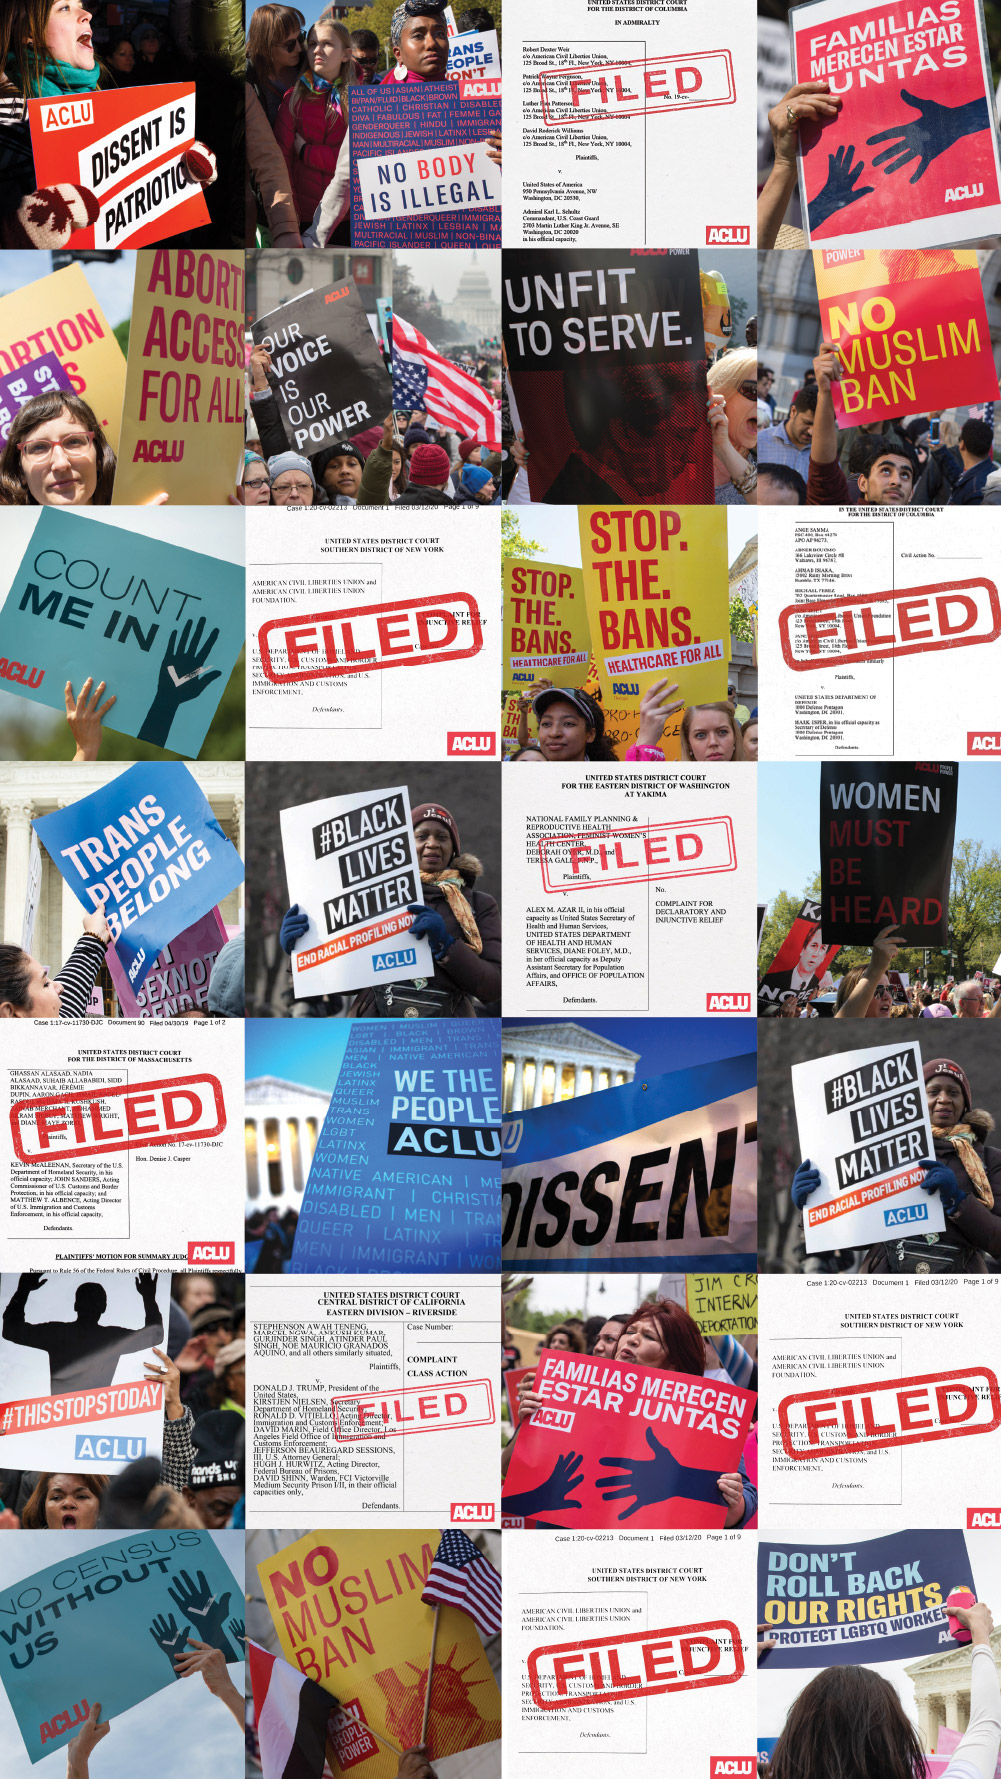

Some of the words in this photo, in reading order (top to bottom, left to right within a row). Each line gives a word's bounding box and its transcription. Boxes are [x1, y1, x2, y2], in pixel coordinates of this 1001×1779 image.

[810, 1, 961, 57] FAMILIAS
[810, 37, 898, 78] MERECEN
[904, 22, 963, 54] ESTAR
[817, 46, 968, 94] UNTAS
[464, 83, 502, 97] ACLU
[569, 66, 703, 107] FILED
[45, 102, 91, 128] ACLU
[92, 116, 162, 188] DISSENT
[170, 107, 185, 139] IS
[377, 162, 407, 185] NO
[417, 153, 475, 180] BODY
[371, 192, 391, 212] IS
[401, 179, 494, 209] ILLEGAL
[945, 183, 984, 202] ACLU
[708, 228, 747, 243] ACLU
[324, 287, 349, 304] ACLU
[505, 268, 635, 313] UNFIT
[142, 306, 245, 369] ACCESS
[509, 321, 552, 356] TO
[562, 311, 692, 354] SERVE.
[829, 297, 896, 339] NO
[270, 335, 332, 379] VOICE
[835, 319, 981, 374] MUSLIM
[139, 370, 201, 423] FOR
[279, 380, 299, 403] IS
[288, 392, 331, 426] OUR
[840, 368, 917, 413] BAN
[294, 401, 371, 450] POWER
[132, 439, 184, 462] ACLU
[590, 509, 688, 554] STOP.
[34, 550, 202, 621] COUNT
[511, 567, 574, 598] STOP.
[592, 559, 671, 602] THE.
[18, 583, 94, 630] ME
[104, 610, 160, 652] IN
[510, 598, 561, 626] THE.
[599, 606, 701, 650] BANS.
[805, 595, 978, 655] FILED
[285, 609, 458, 668] FILED
[511, 628, 576, 654] BANS.
[512, 657, 562, 667] HEALTHCARE
[563, 656, 576, 664] FOR
[576, 654, 586, 663] ALL
[512, 673, 534, 682] ACLU
[608, 650, 679, 675] HEALTHCARE
[680, 648, 701, 664] FOR
[703, 644, 722, 660] ALL
[613, 683, 639, 696] ACLU
[452, 737, 491, 751] ACLU
[830, 782, 940, 813] WOMEN
[60, 795, 166, 880] TRANS
[320, 798, 402, 854] #BLACK
[830, 820, 910, 848] MUST
[85, 815, 192, 909] PEOPLE
[345, 838, 405, 881] LIVES
[569, 833, 704, 874] FILED
[830, 858, 862, 886] BE
[104, 839, 212, 947] BELONG
[328, 876, 412, 929] MATTER
[830, 896, 943, 926] HEARD
[128, 947, 146, 984] ACLU
[297, 954, 316, 968] END
[318, 940, 349, 960] RACIAL
[350, 922, 397, 949] PROFILING
[375, 951, 414, 970] ACLU
[709, 996, 748, 1010] ACLU
[394, 1070, 435, 1092] WE
[443, 1068, 496, 1092] THE
[831, 1053, 914, 1109] #BLACK
[36, 1089, 203, 1149] FILED
[392, 1096, 501, 1123] PEOPLE
[857, 1093, 917, 1136] LIVES
[394, 1127, 501, 1157] ACLU
[840, 1131, 924, 1184] MATTER
[306, 1184, 395, 1199] IMMIGRANT
[311, 1168, 362, 1181] NATIVE
[372, 1171, 453, 1186] AMERICAN
[502, 1121, 757, 1248] DISSEN
[303, 1201, 381, 1219] DISABLED
[405, 1208, 441, 1223] MEN
[809, 1209, 828, 1223] END
[829, 1195, 860, 1215] RACIAL
[861, 1177, 909, 1203] PROFILING
[887, 1206, 925, 1225] ACLU
[193, 1247, 230, 1260] ACLU
[694, 1277, 722, 1293] JIM
[2, 1384, 161, 1430] #THISSTOPSTODAY
[543, 1358, 638, 1393] FAMILIAS
[640, 1377, 746, 1418] MERECEN
[358, 1392, 468, 1427] FILED
[533, 1409, 573, 1429] ACLU
[538, 1379, 624, 1413] ESTAR
[629, 1398, 740, 1439] JUNTAS
[805, 1384, 977, 1444] FILED
[78, 1437, 142, 1459] ACLU
[453, 1505, 492, 1520] ACLU
[0, 1587, 42, 1615] NO
[53, 1532, 201, 1590] CENSUS
[269, 1546, 339, 1609] NO
[767, 1575, 839, 1598] ROLL
[848, 1560, 924, 1595] BACK
[0, 1557, 171, 1646] WITHOUT
[282, 1543, 436, 1648] MUSLIM
[764, 1600, 828, 1624] OUR
[837, 1583, 943, 1623] RIGHTS
[10, 1631, 59, 1669] US
[295, 1618, 375, 1683] BAN
[769, 1631, 837, 1644] PROTECT
[841, 1623, 888, 1639] LGBTQ
[553, 1636, 721, 1696] FILED
[39, 1698, 91, 1744] ACLU
[338, 1736, 373, 1764] POWER
[715, 1760, 752, 1774] ACLU
